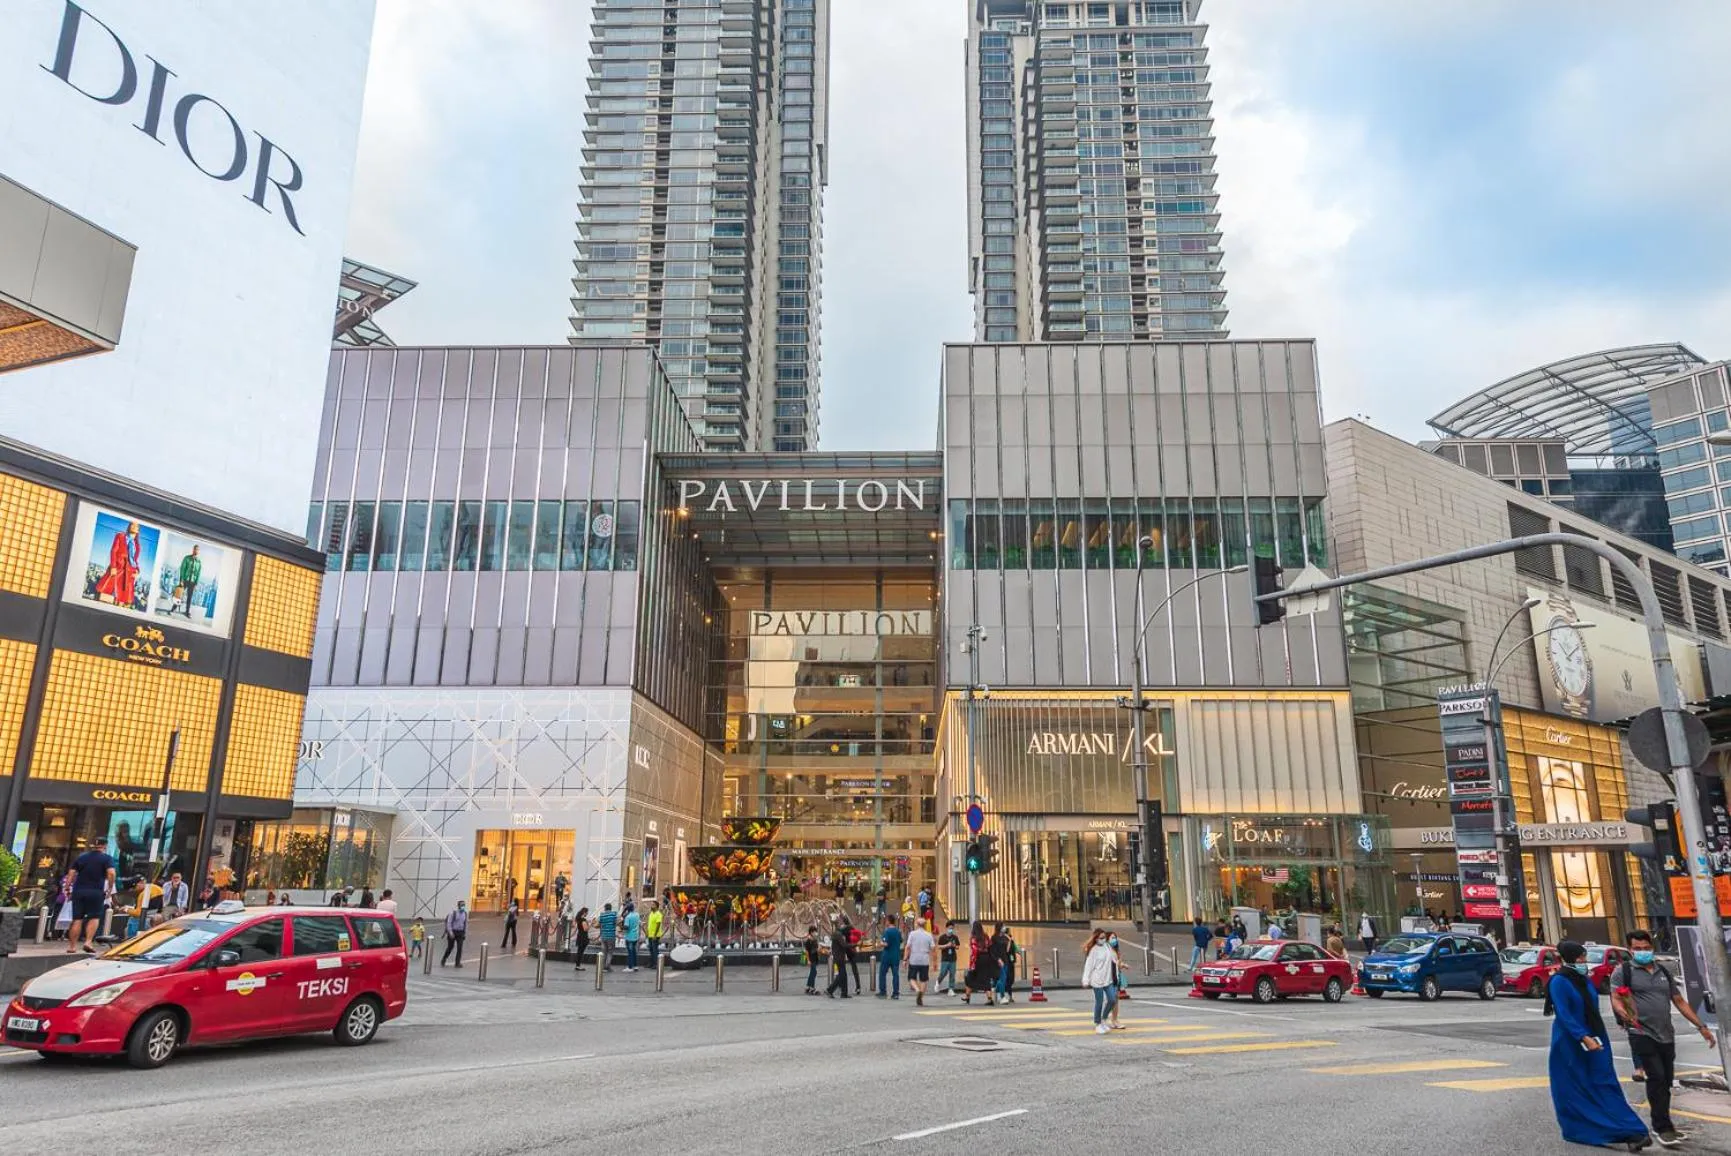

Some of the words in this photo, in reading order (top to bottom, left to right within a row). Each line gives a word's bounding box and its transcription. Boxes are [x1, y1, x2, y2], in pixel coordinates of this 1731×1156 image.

[39, 0, 306, 237] DIOR
[677, 479, 926, 513] PAVILION
[753, 612, 921, 636] PAVILION
[102, 634, 190, 662] COACH
[1027, 733, 1115, 755] ARMANI
[1545, 725, 1572, 745] Cartier
[92, 789, 153, 803] COACH
[1391, 781, 1448, 801] Cartier
[1233, 828, 1284, 843] LOAF
[1537, 826, 1627, 842] ENTRANCE
[1423, 889, 1445, 899] artier
[297, 976, 350, 1000] TEKSI
